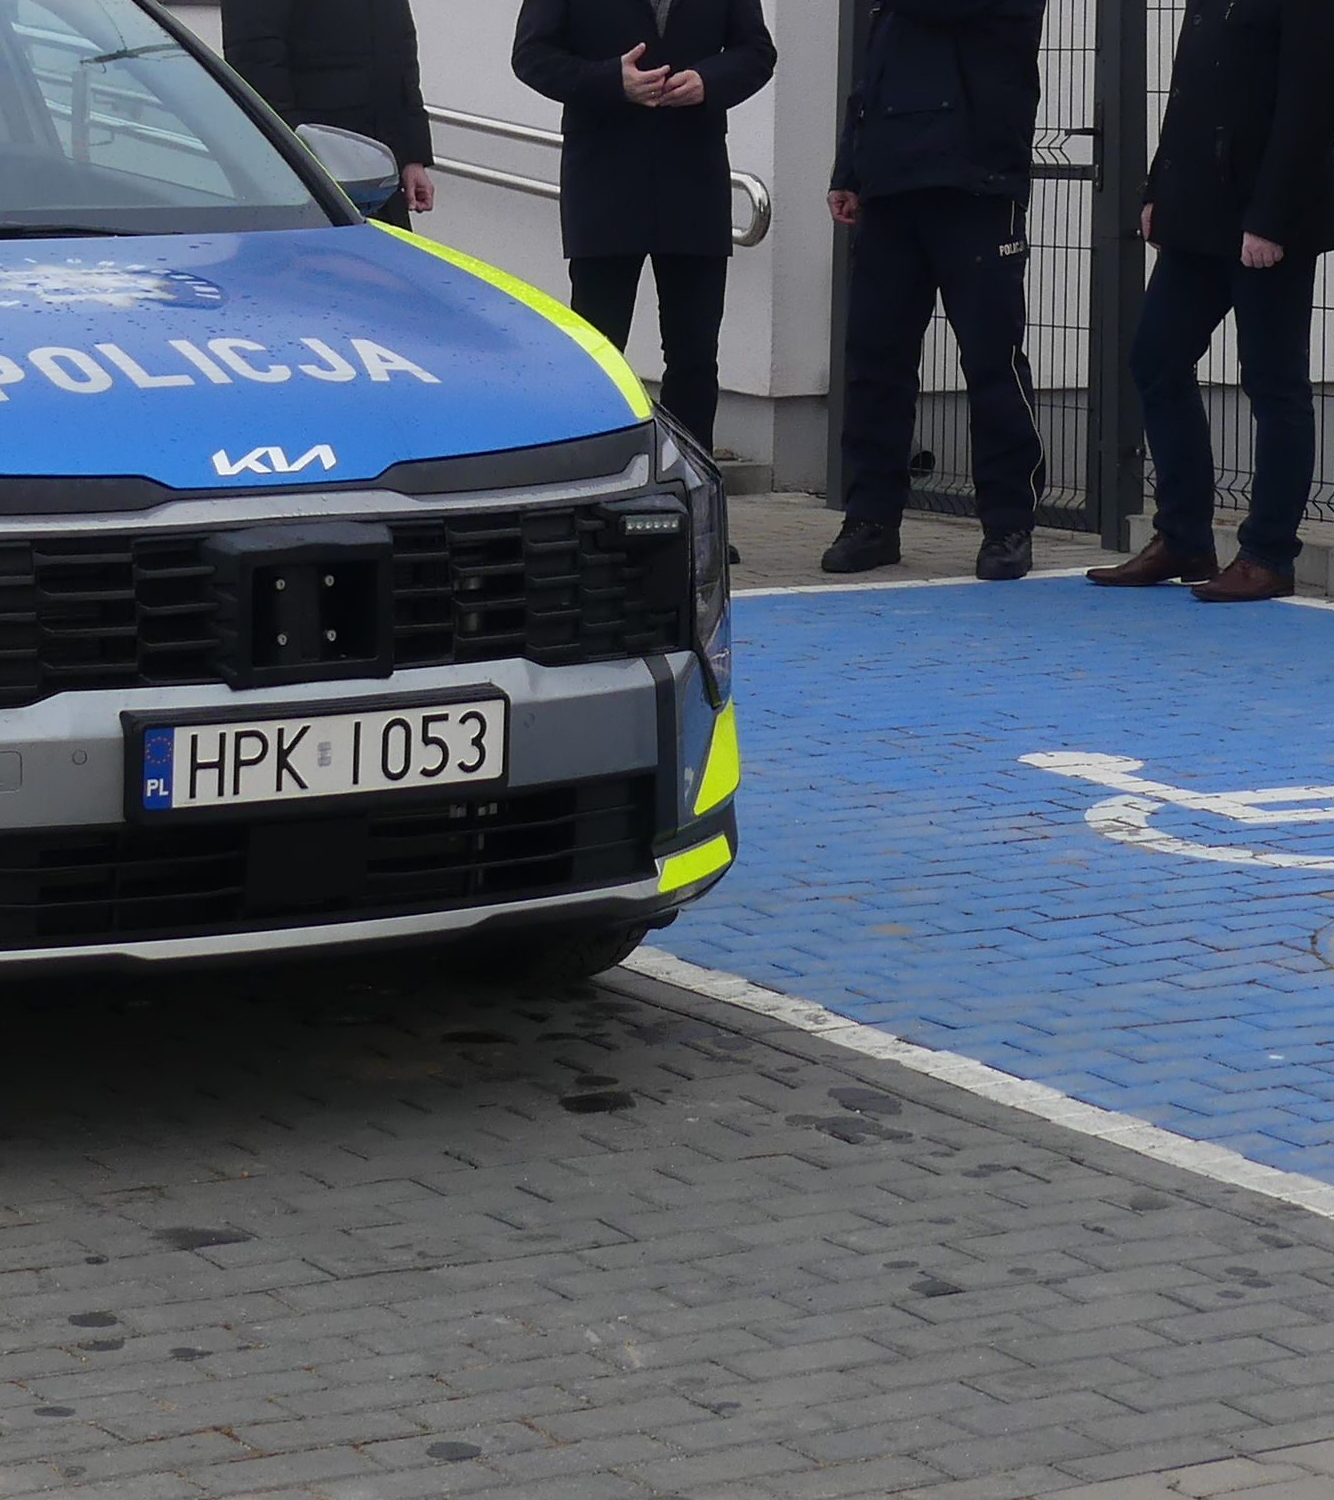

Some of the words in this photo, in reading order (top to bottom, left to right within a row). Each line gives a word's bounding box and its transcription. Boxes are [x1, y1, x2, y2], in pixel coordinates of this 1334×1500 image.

[211, 444, 337, 476] KIA
[189, 725, 311, 799] HPK
[146, 778, 169, 797] PL
